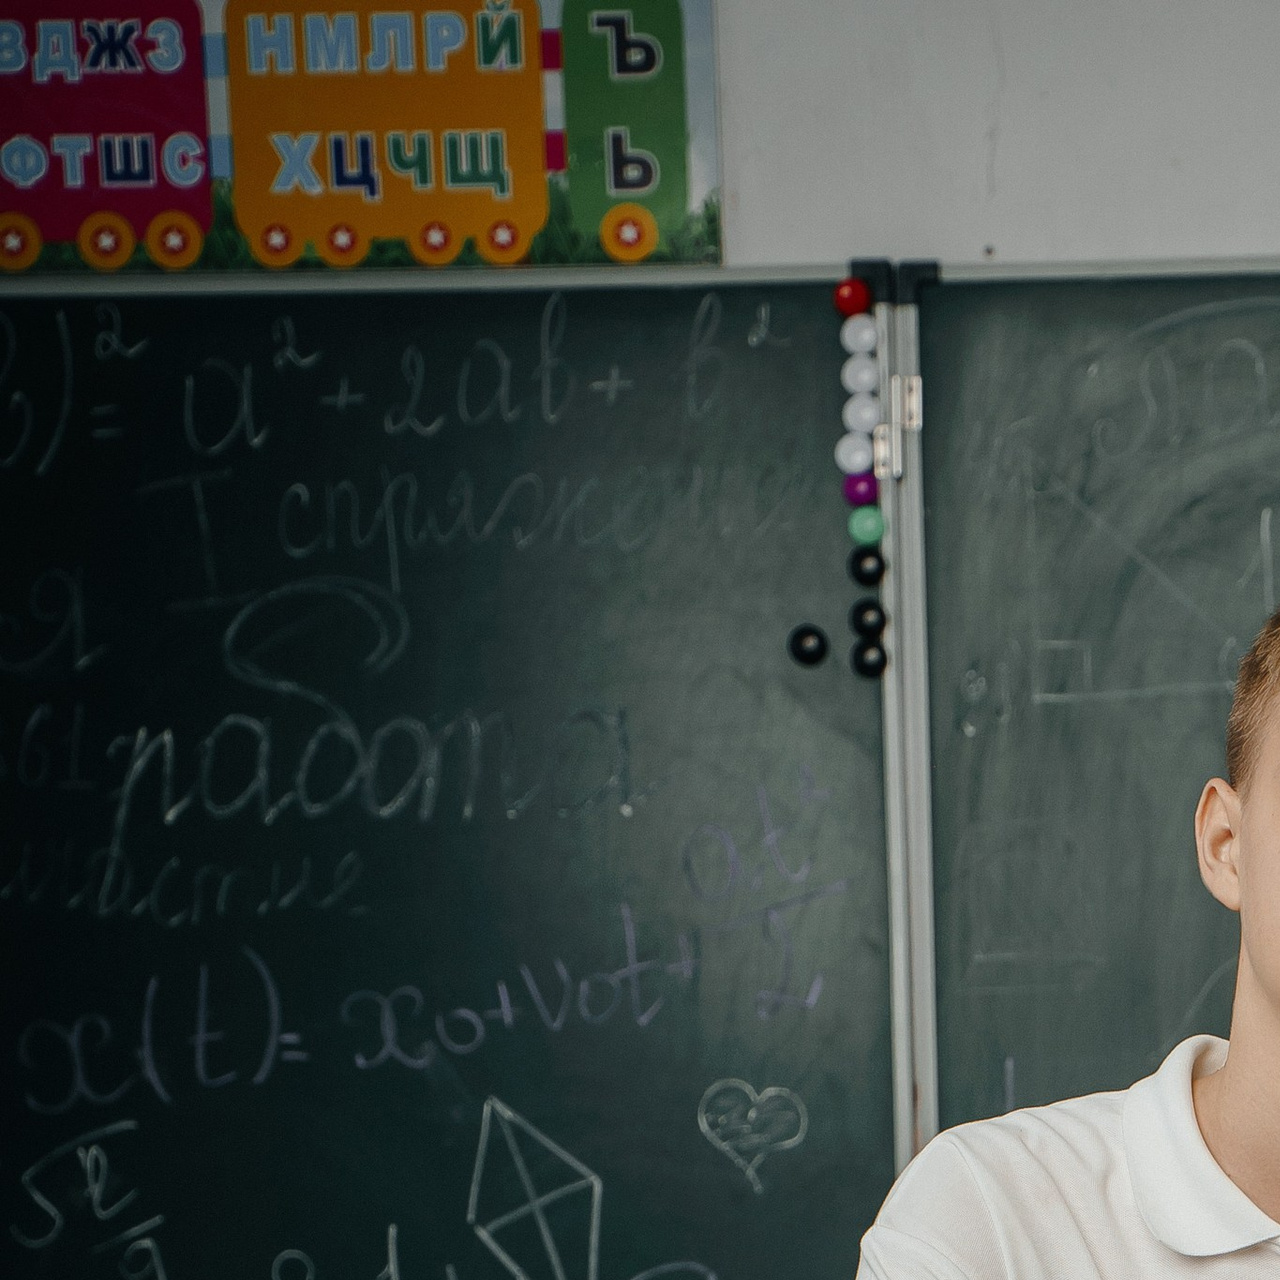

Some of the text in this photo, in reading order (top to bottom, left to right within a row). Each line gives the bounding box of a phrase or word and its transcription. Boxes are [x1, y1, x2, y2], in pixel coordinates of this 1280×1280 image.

[246, 0, 524, 75] НМЛРЙ
[590, 9, 664, 77] Ъ
[0, 131, 206, 189] ФТШС
[269, 129, 511, 201] ХЦЧЩ
[606, 126, 661, 196] Ь
